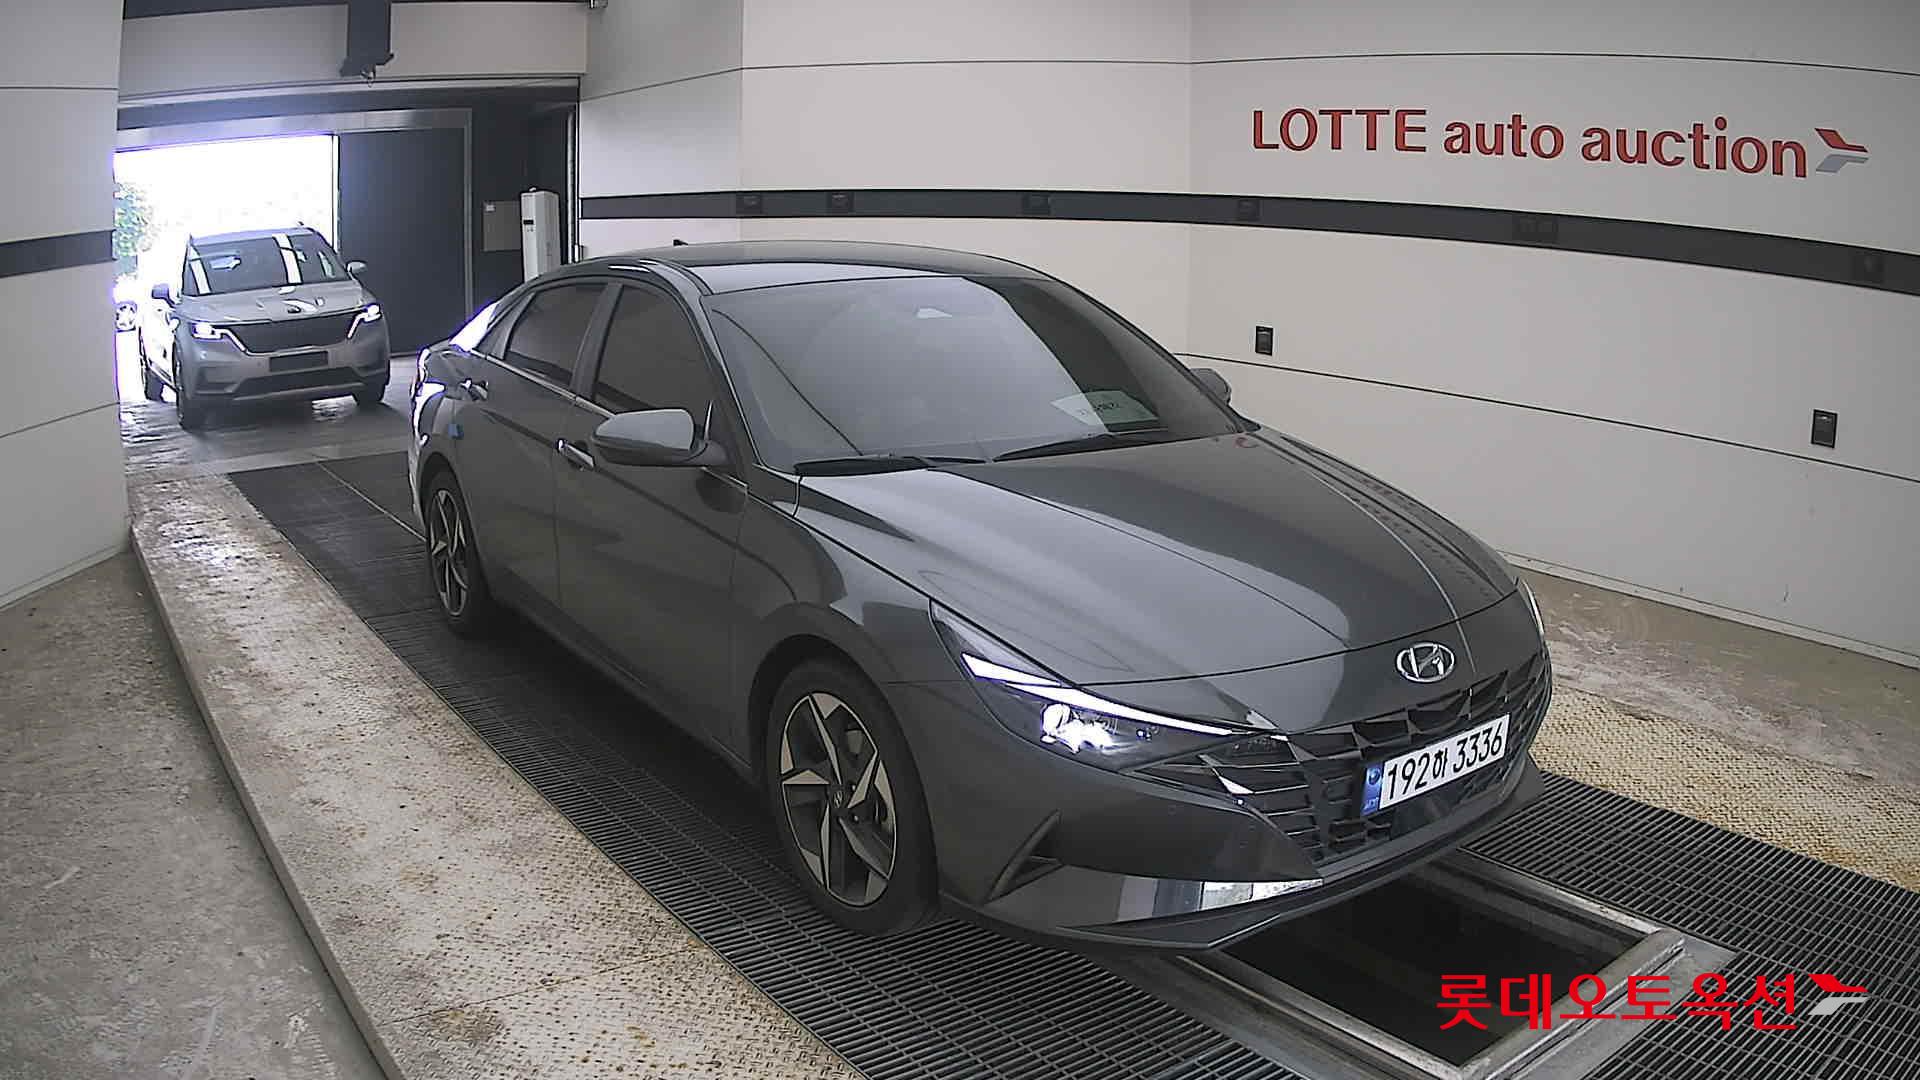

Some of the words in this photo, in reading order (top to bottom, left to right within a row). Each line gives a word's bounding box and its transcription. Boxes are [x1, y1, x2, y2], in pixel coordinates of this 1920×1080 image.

[1253, 107, 1428, 153] LOTTE
[1443, 114, 1565, 160] auto
[1580, 115, 1808, 179] auction
[1387, 747, 1449, 800] 192하
[1452, 721, 1502, 774] 3336
